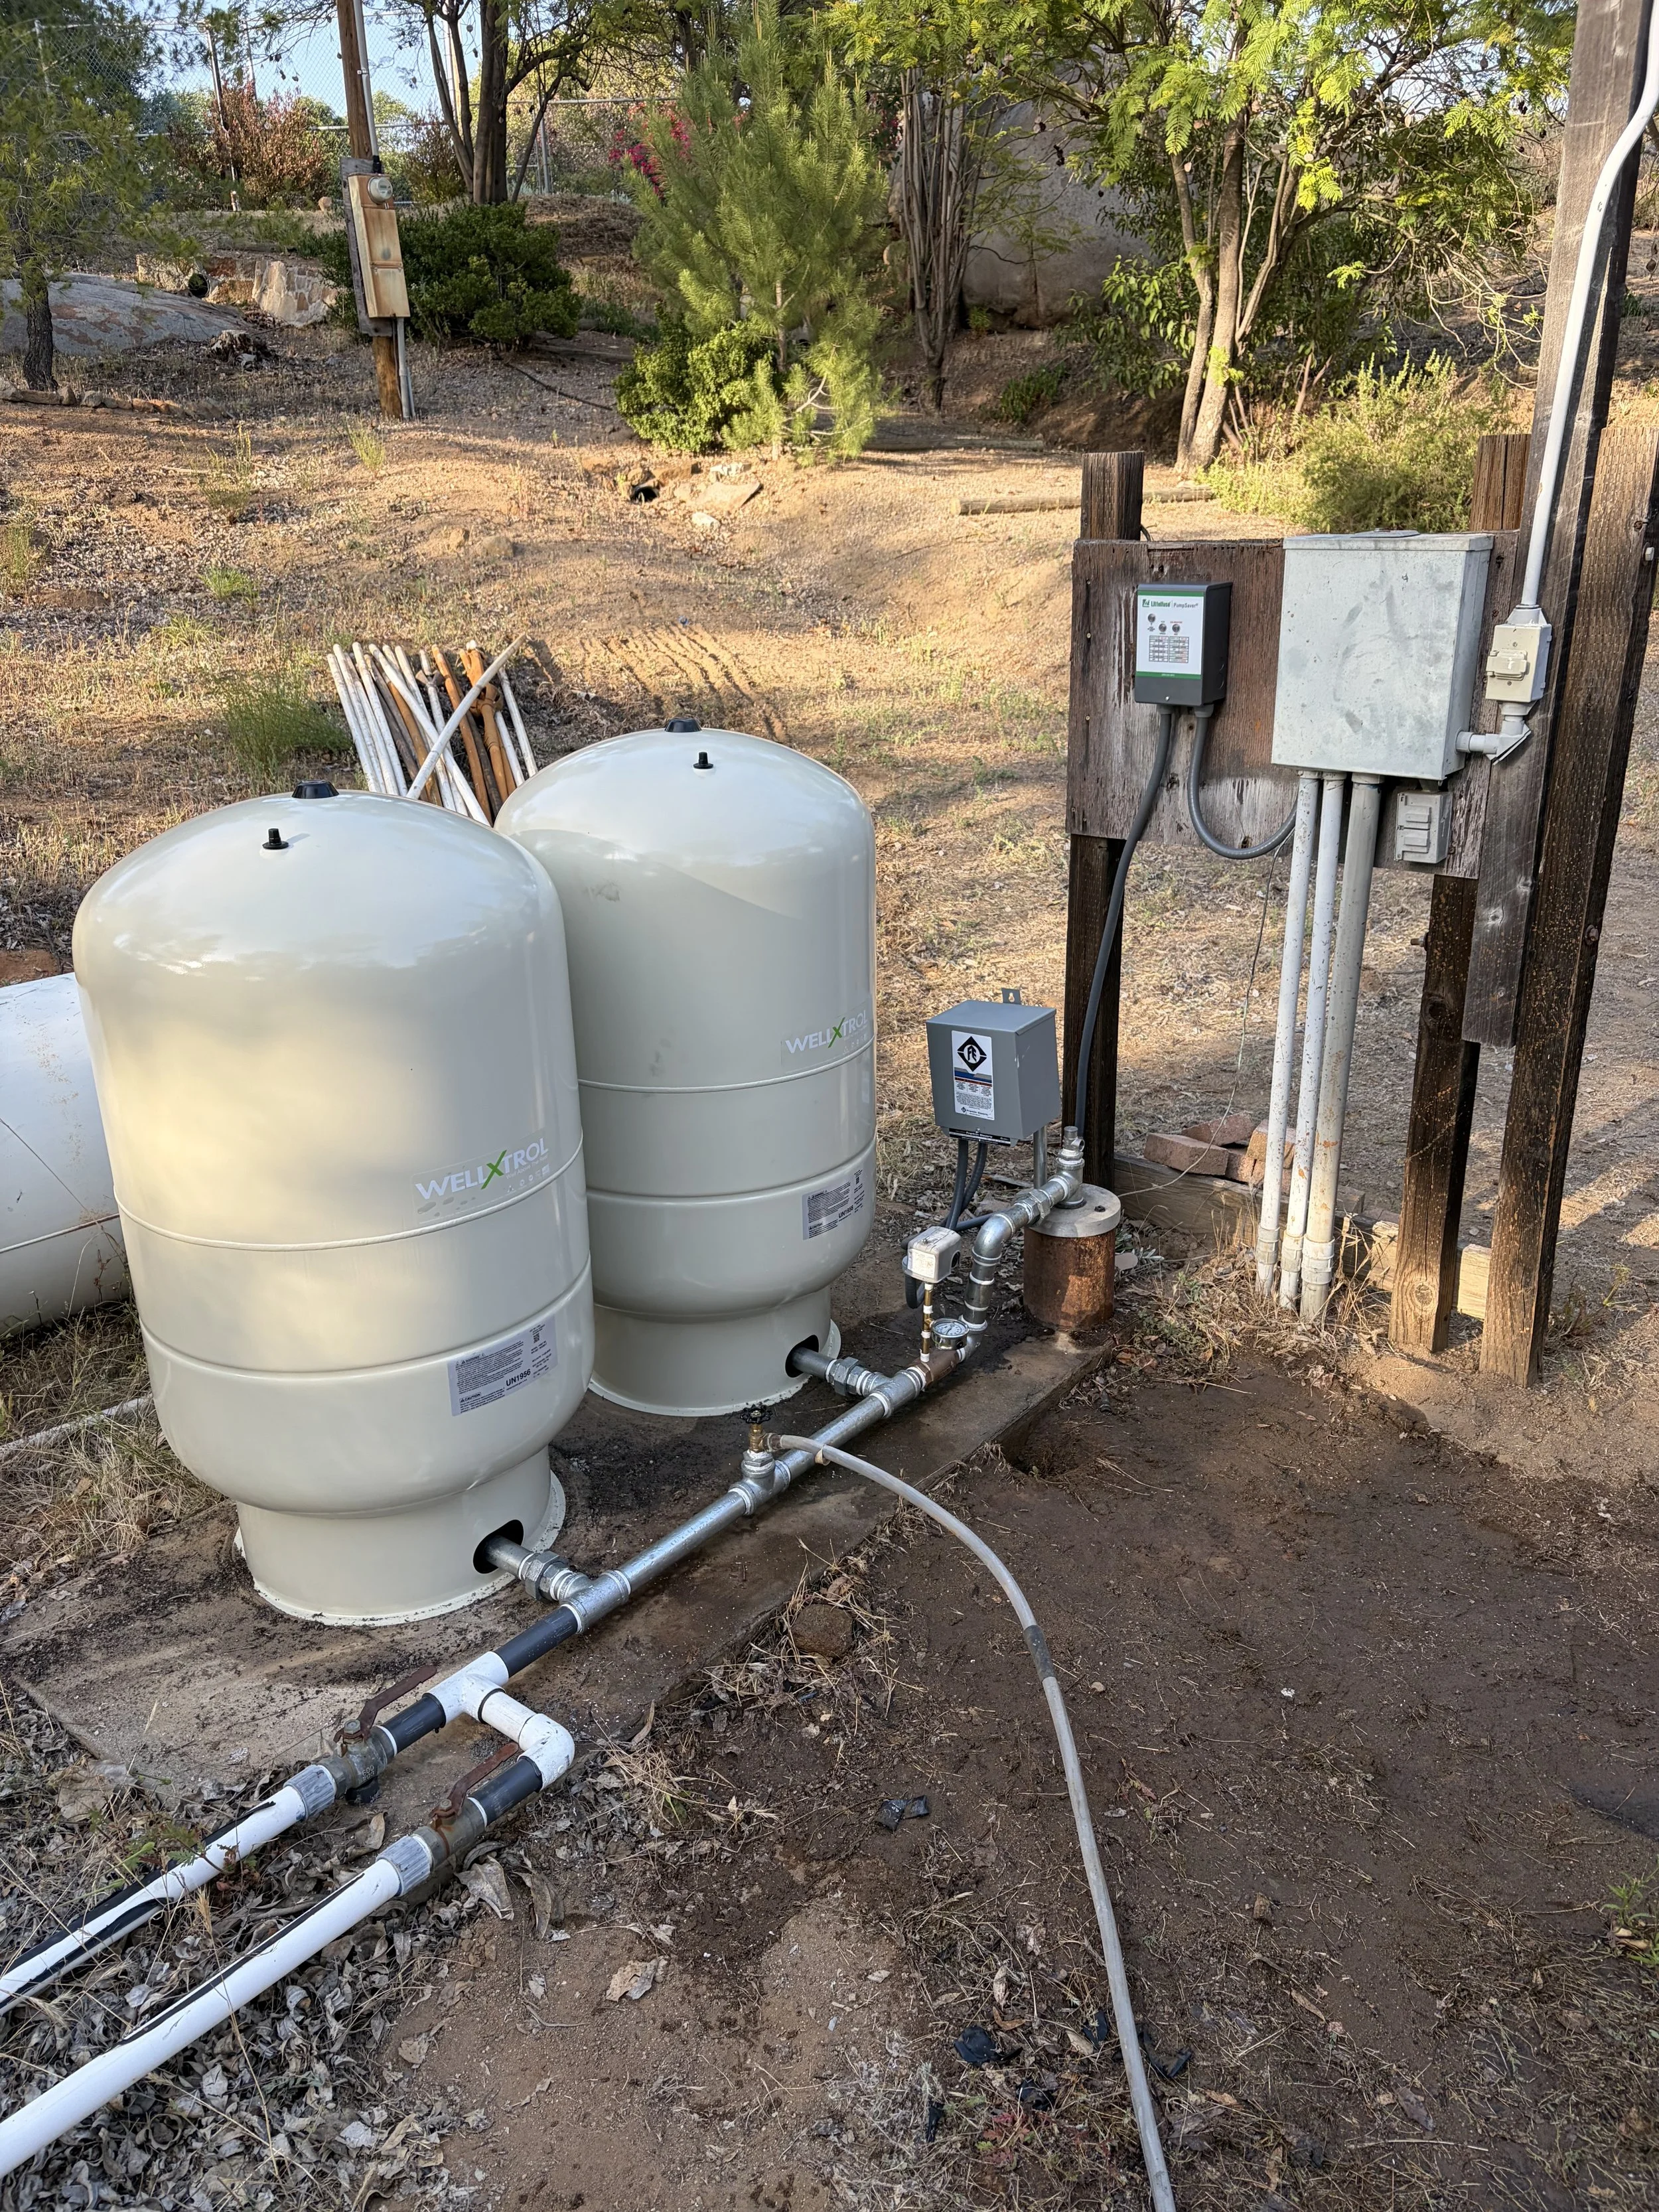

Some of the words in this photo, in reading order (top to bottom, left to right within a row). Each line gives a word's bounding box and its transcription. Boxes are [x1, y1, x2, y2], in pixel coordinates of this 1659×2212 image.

[415, 1138, 549, 1200] WELLXTROL
[506, 1368, 531, 1386] UN1956
[362, 1765, 374, 1777] 600
